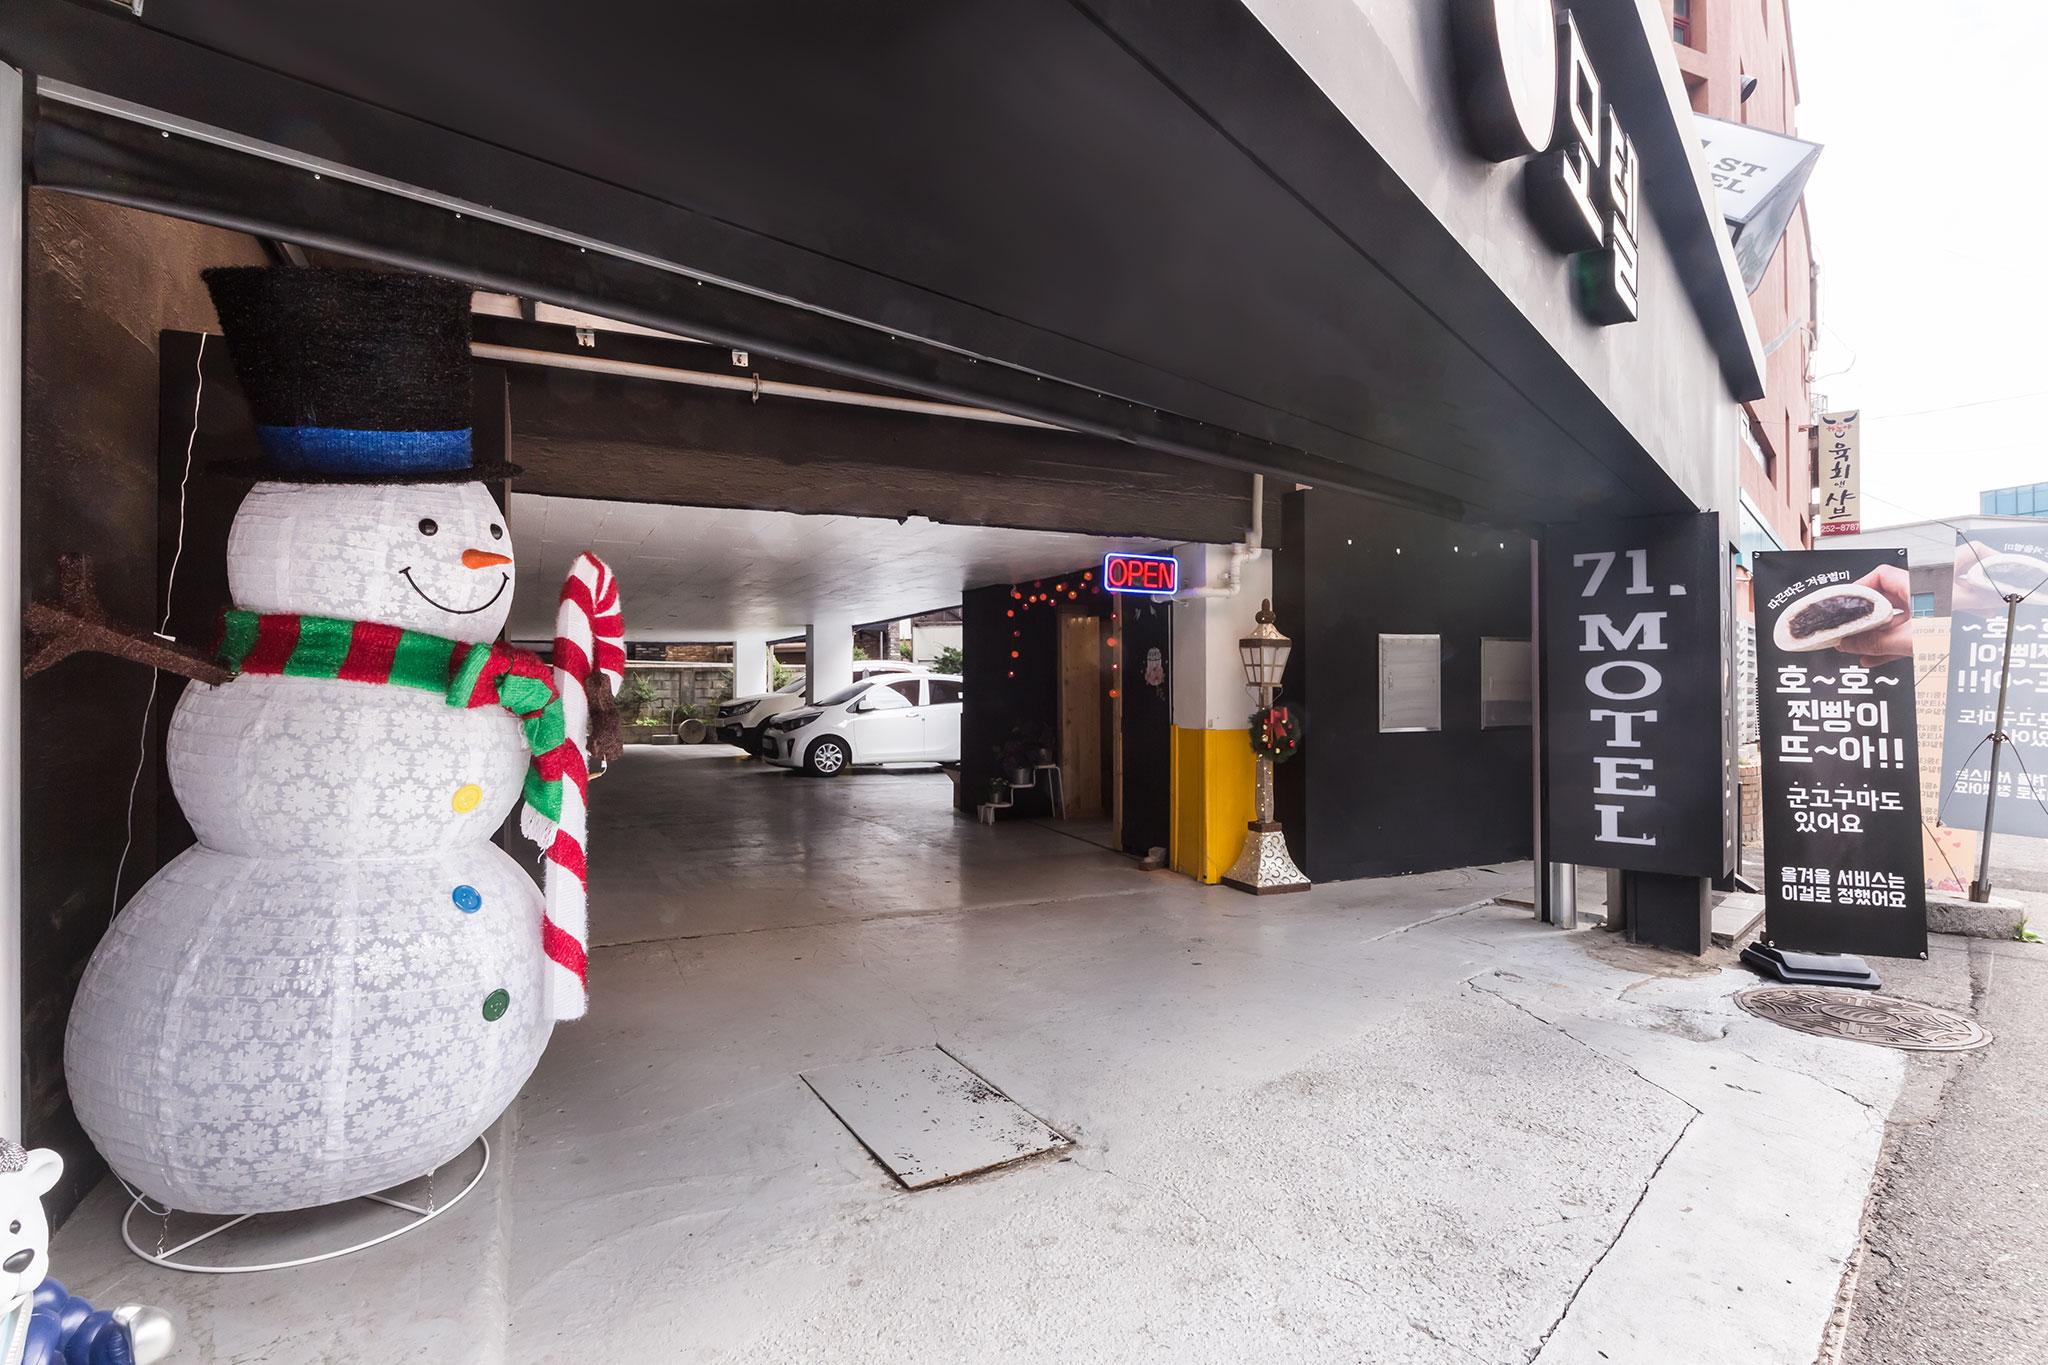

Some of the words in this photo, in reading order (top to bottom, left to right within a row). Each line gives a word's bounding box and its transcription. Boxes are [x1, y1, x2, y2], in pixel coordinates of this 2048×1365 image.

[1108, 558, 1175, 589] OPEN
[1767, 581, 1806, 610] 따끈따끈
[1805, 570, 1850, 587] 겨울별미
[1578, 611, 1668, 846] MOTEL
[1787, 699, 1889, 734] 찐빵이
[1779, 735, 1904, 769] 뜨~아!!
[1786, 785, 1904, 812] 군고구마도
[1793, 811, 1864, 834] 있어요
[1781, 866, 1831, 885] 올겨울
[1837, 869, 1906, 890] 서비스는
[1782, 884, 1832, 904] 이걸로
[1837, 887, 1907, 908] 정했어요
